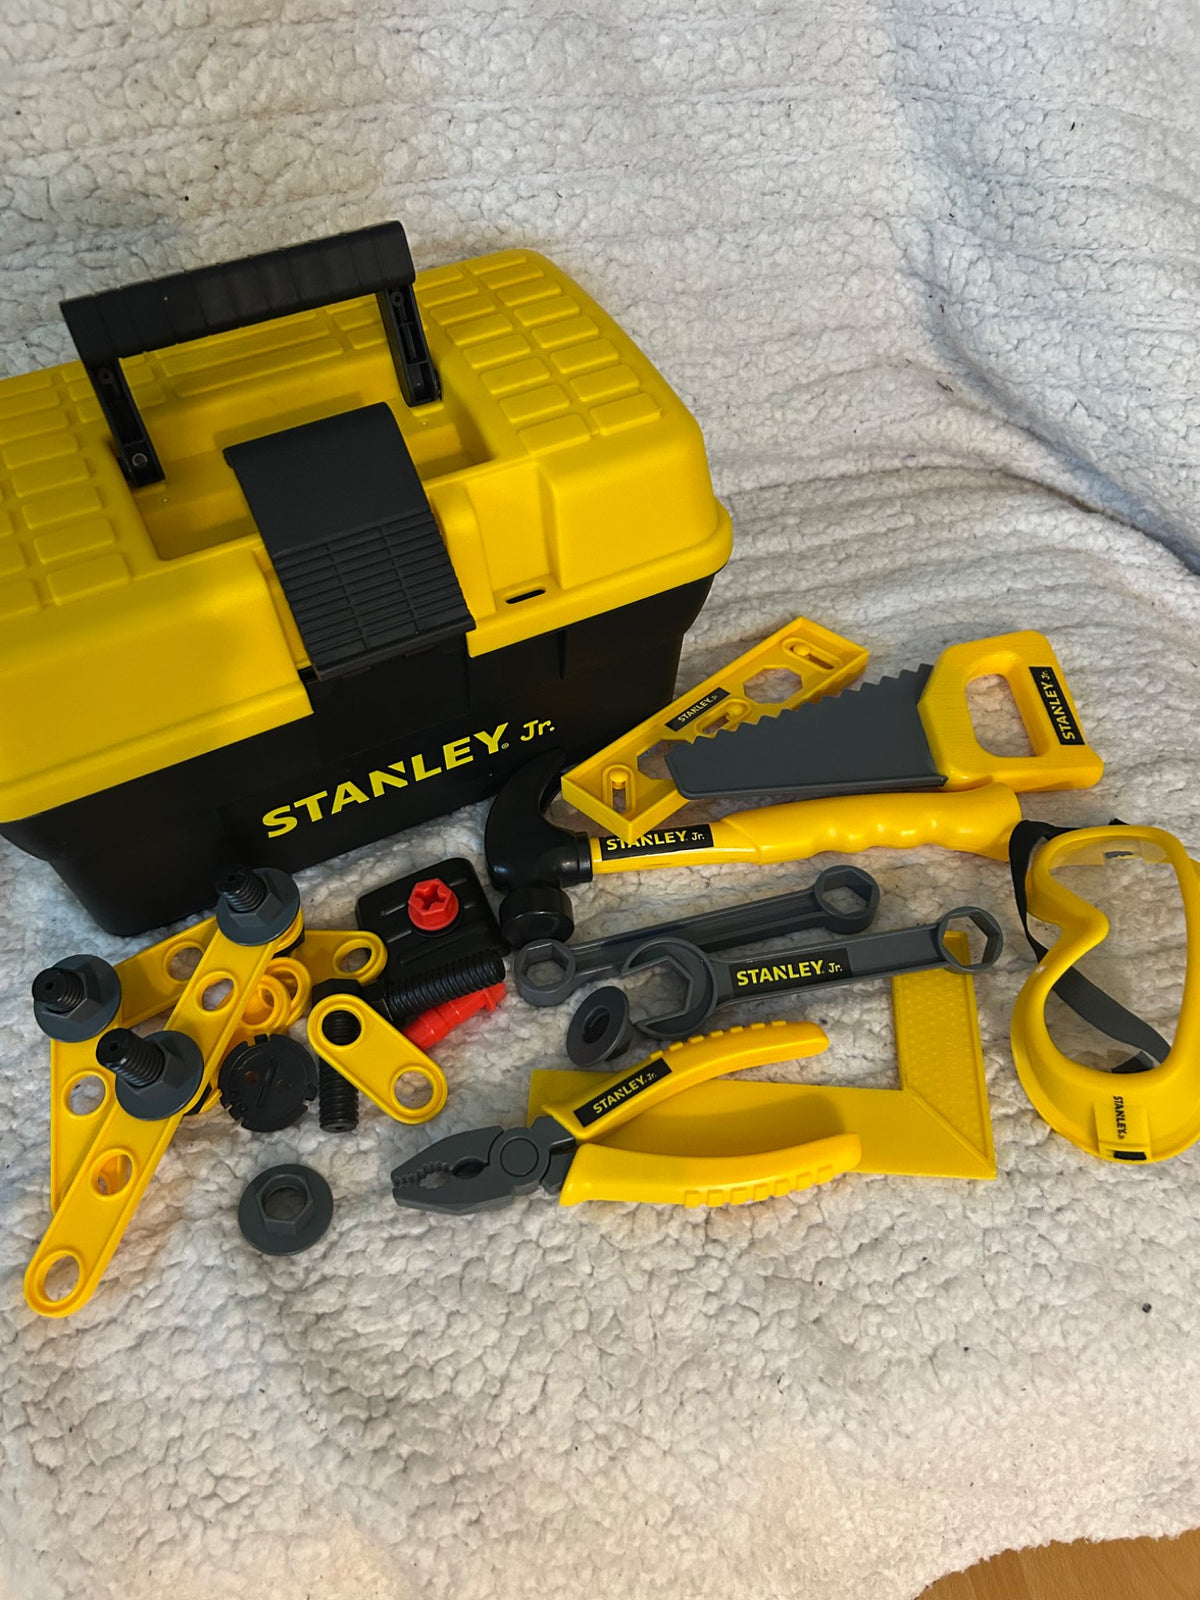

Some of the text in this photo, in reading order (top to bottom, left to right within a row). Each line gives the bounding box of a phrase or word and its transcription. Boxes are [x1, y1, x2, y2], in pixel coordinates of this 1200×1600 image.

[677, 697, 712, 723] STANLEY
[1040, 681, 1076, 741] STANLEY
[262, 719, 556, 838] STANLEY Jr.
[691, 831, 705, 841] Jr.
[736, 960, 843, 986] STANLEY Jr.
[592, 1074, 646, 1114] STANLEY
[1112, 1095, 1127, 1135] STANLEY
